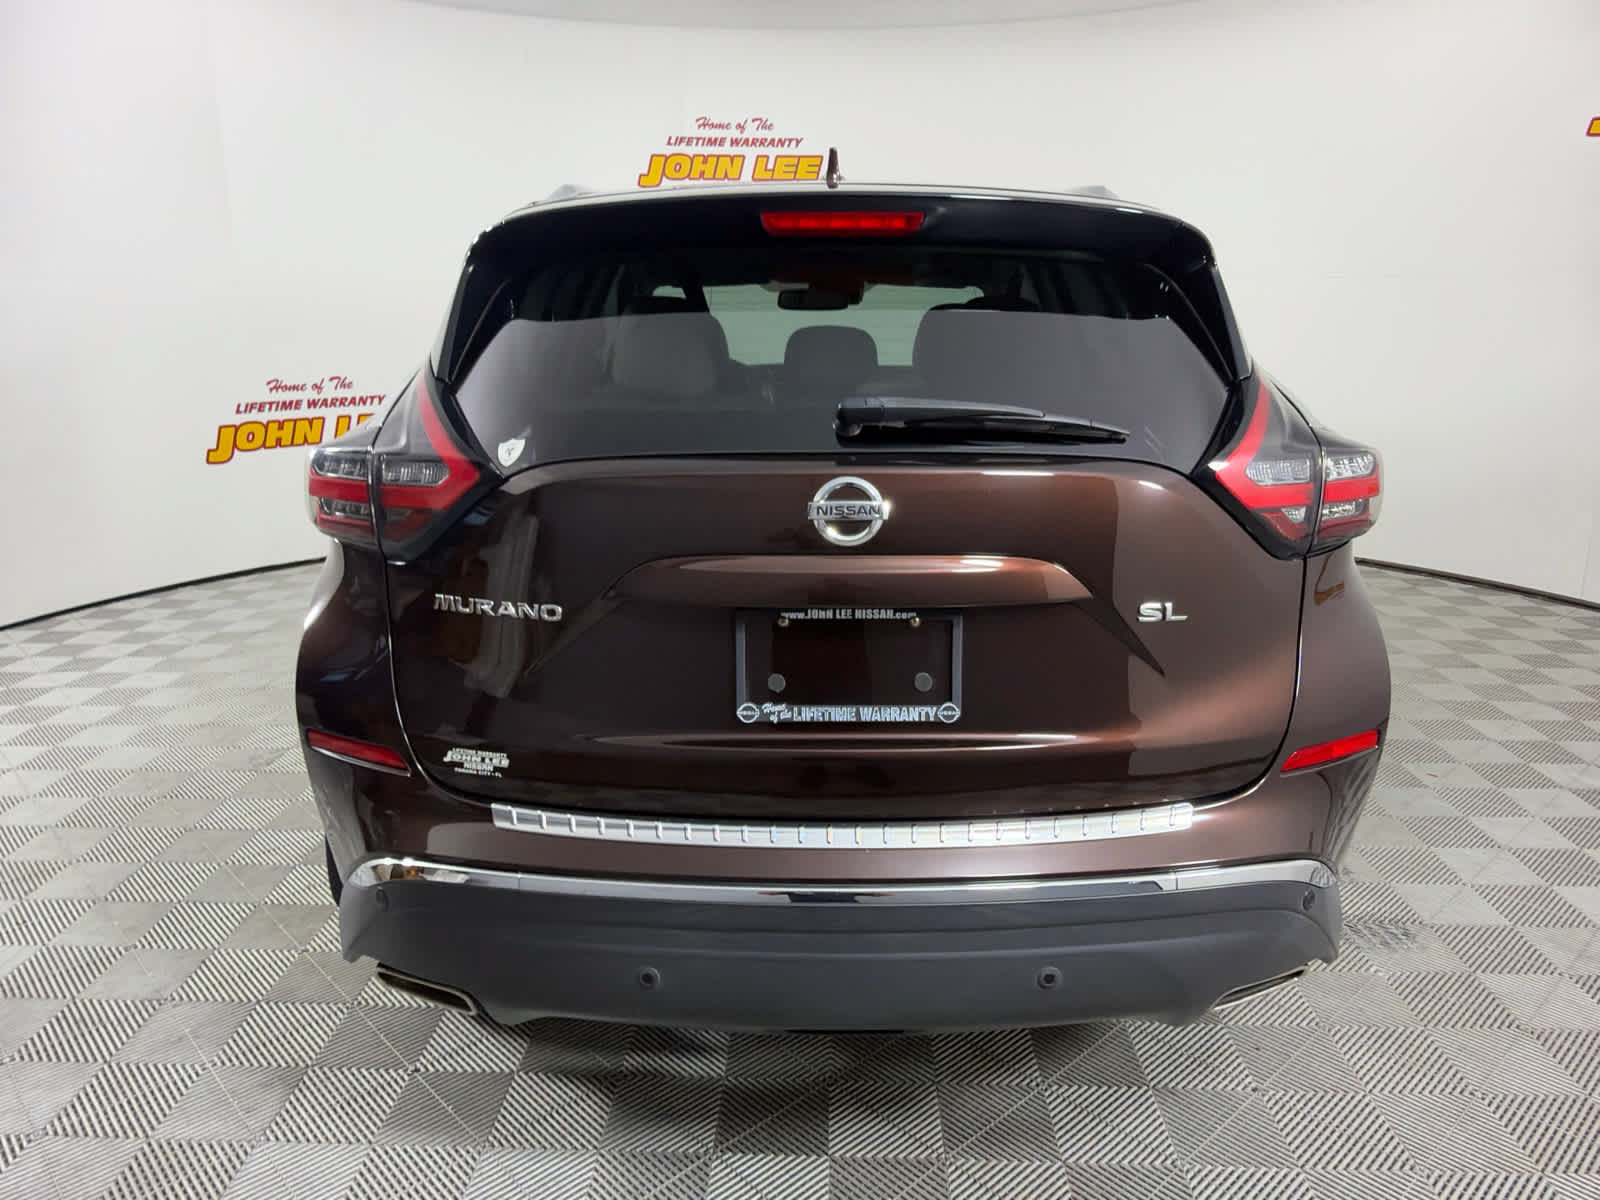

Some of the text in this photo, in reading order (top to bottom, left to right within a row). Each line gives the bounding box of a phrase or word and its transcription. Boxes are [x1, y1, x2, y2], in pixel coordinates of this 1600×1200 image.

[695, 116, 774, 134] Home of The
[666, 135, 803, 148] LIFETIME WARRANTY
[638, 153, 824, 188] JOHN LEE
[266, 376, 353, 395] Home of The
[235, 394, 386, 414] LIFETIME WARRANTY
[206, 416, 325, 464] JOHN
[816, 503, 881, 516] NISSAN
[433, 593, 563, 622] MURANO
[836, 608, 853, 619] LEE
[1137, 601, 1188, 622] SL
[793, 706, 937, 721] LIFETIME WARRANTY
[443, 750, 510, 768] JOHN LEE
